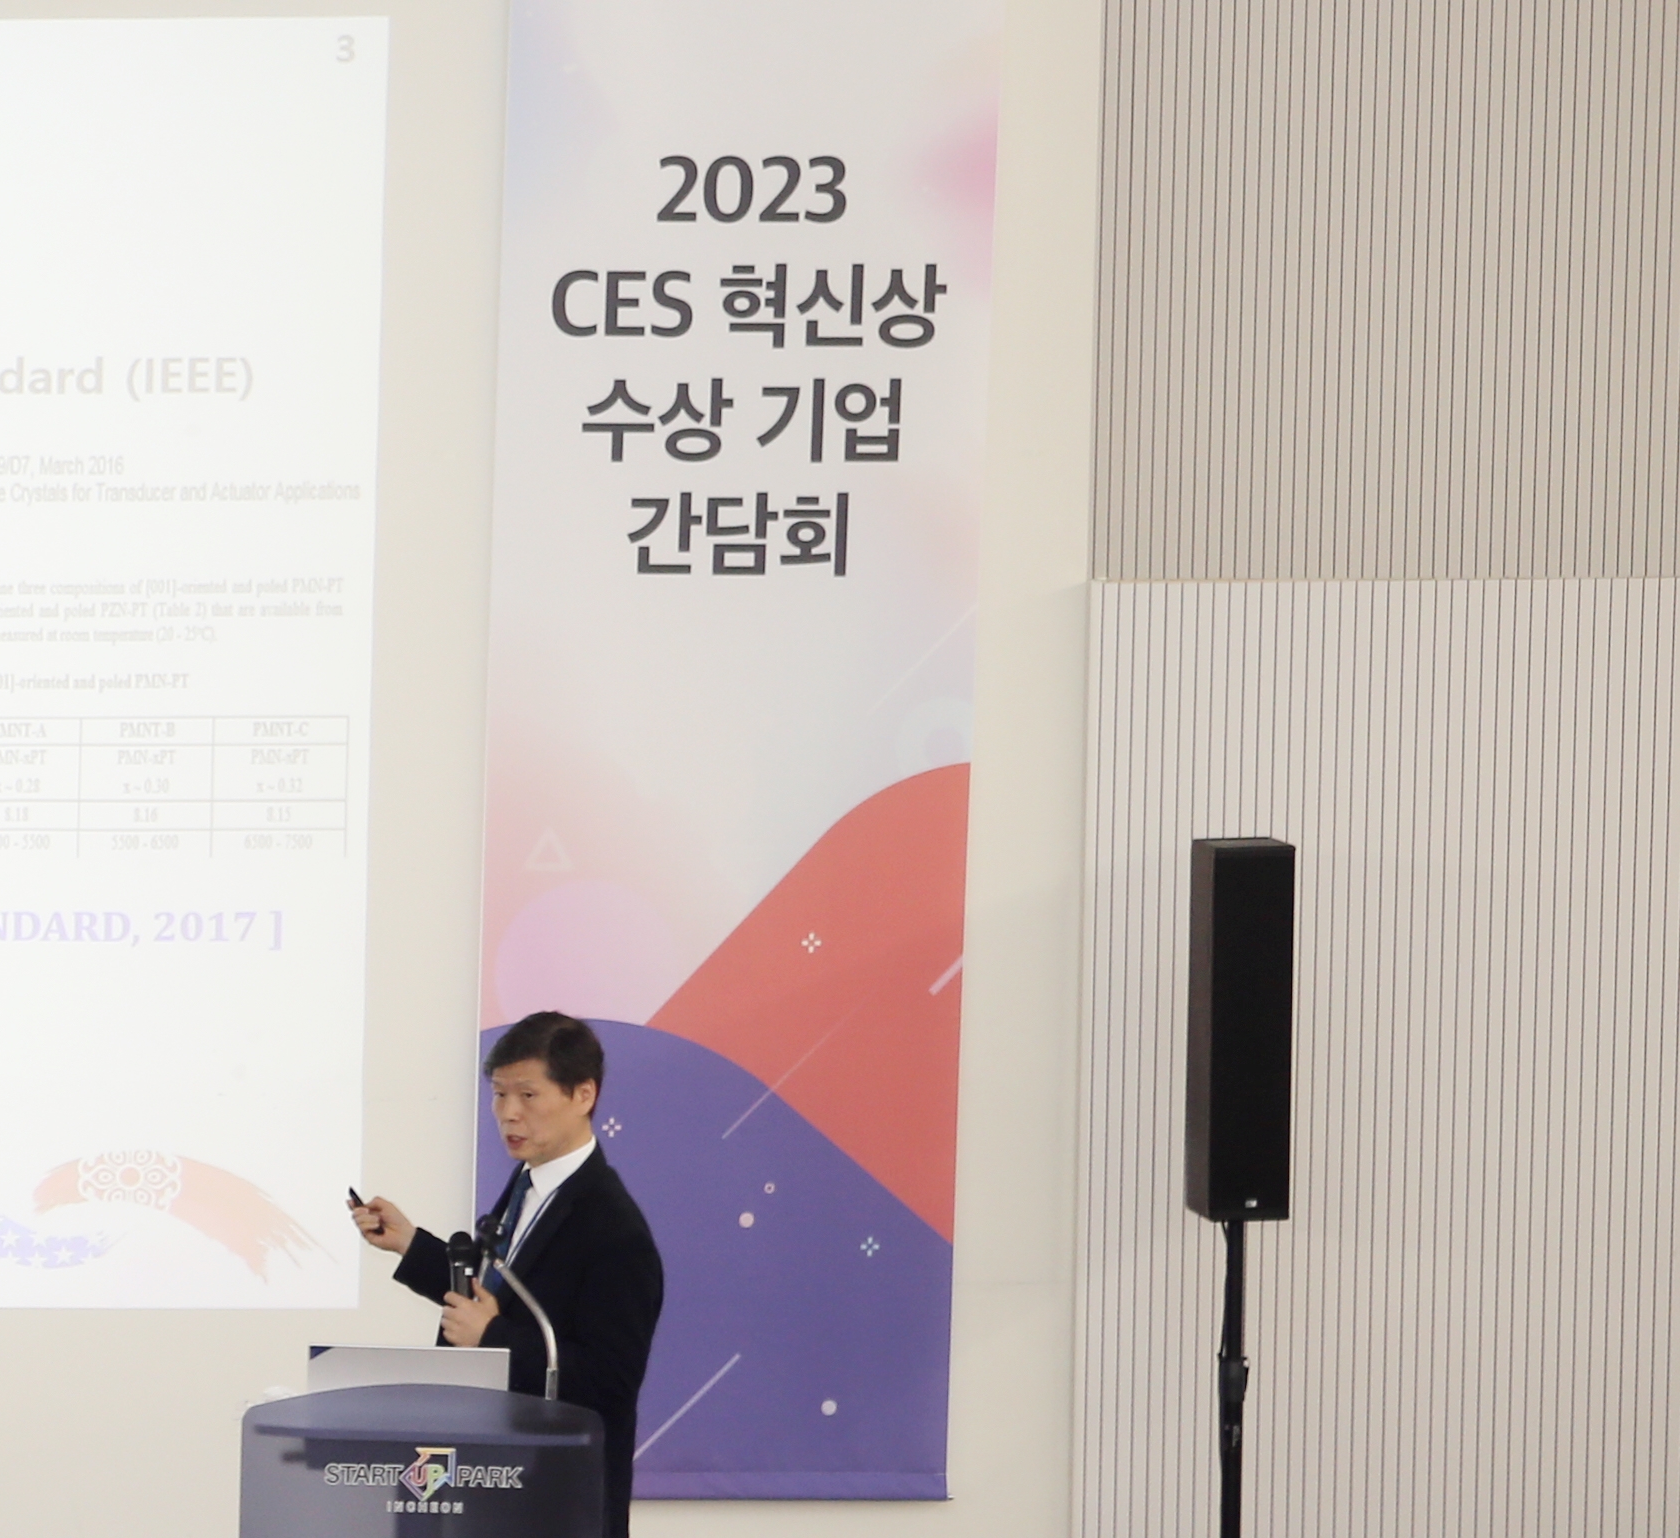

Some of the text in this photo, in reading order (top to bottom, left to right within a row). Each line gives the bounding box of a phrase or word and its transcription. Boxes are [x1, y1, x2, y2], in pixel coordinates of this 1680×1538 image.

[335, 35, 356, 63] 3
[656, 154, 848, 224] 2023
[551, 262, 948, 348] CES 혁신상
[126, 356, 255, 401] (IEEE)
[582, 377, 904, 464] 수상 기업
[9, 482, 70, 507] Crystals
[71, 481, 93, 504] for
[95, 481, 178, 503] Transducer
[179, 482, 209, 503] and
[209, 481, 273, 503] Actuator
[272, 479, 364, 506] Applications
[627, 490, 850, 577] 간담회
[153, 910, 258, 943] 2017
[323, 1462, 404, 1487] START
[457, 1464, 524, 1489] PARK
[385, 1500, 464, 1515] INCHEON
